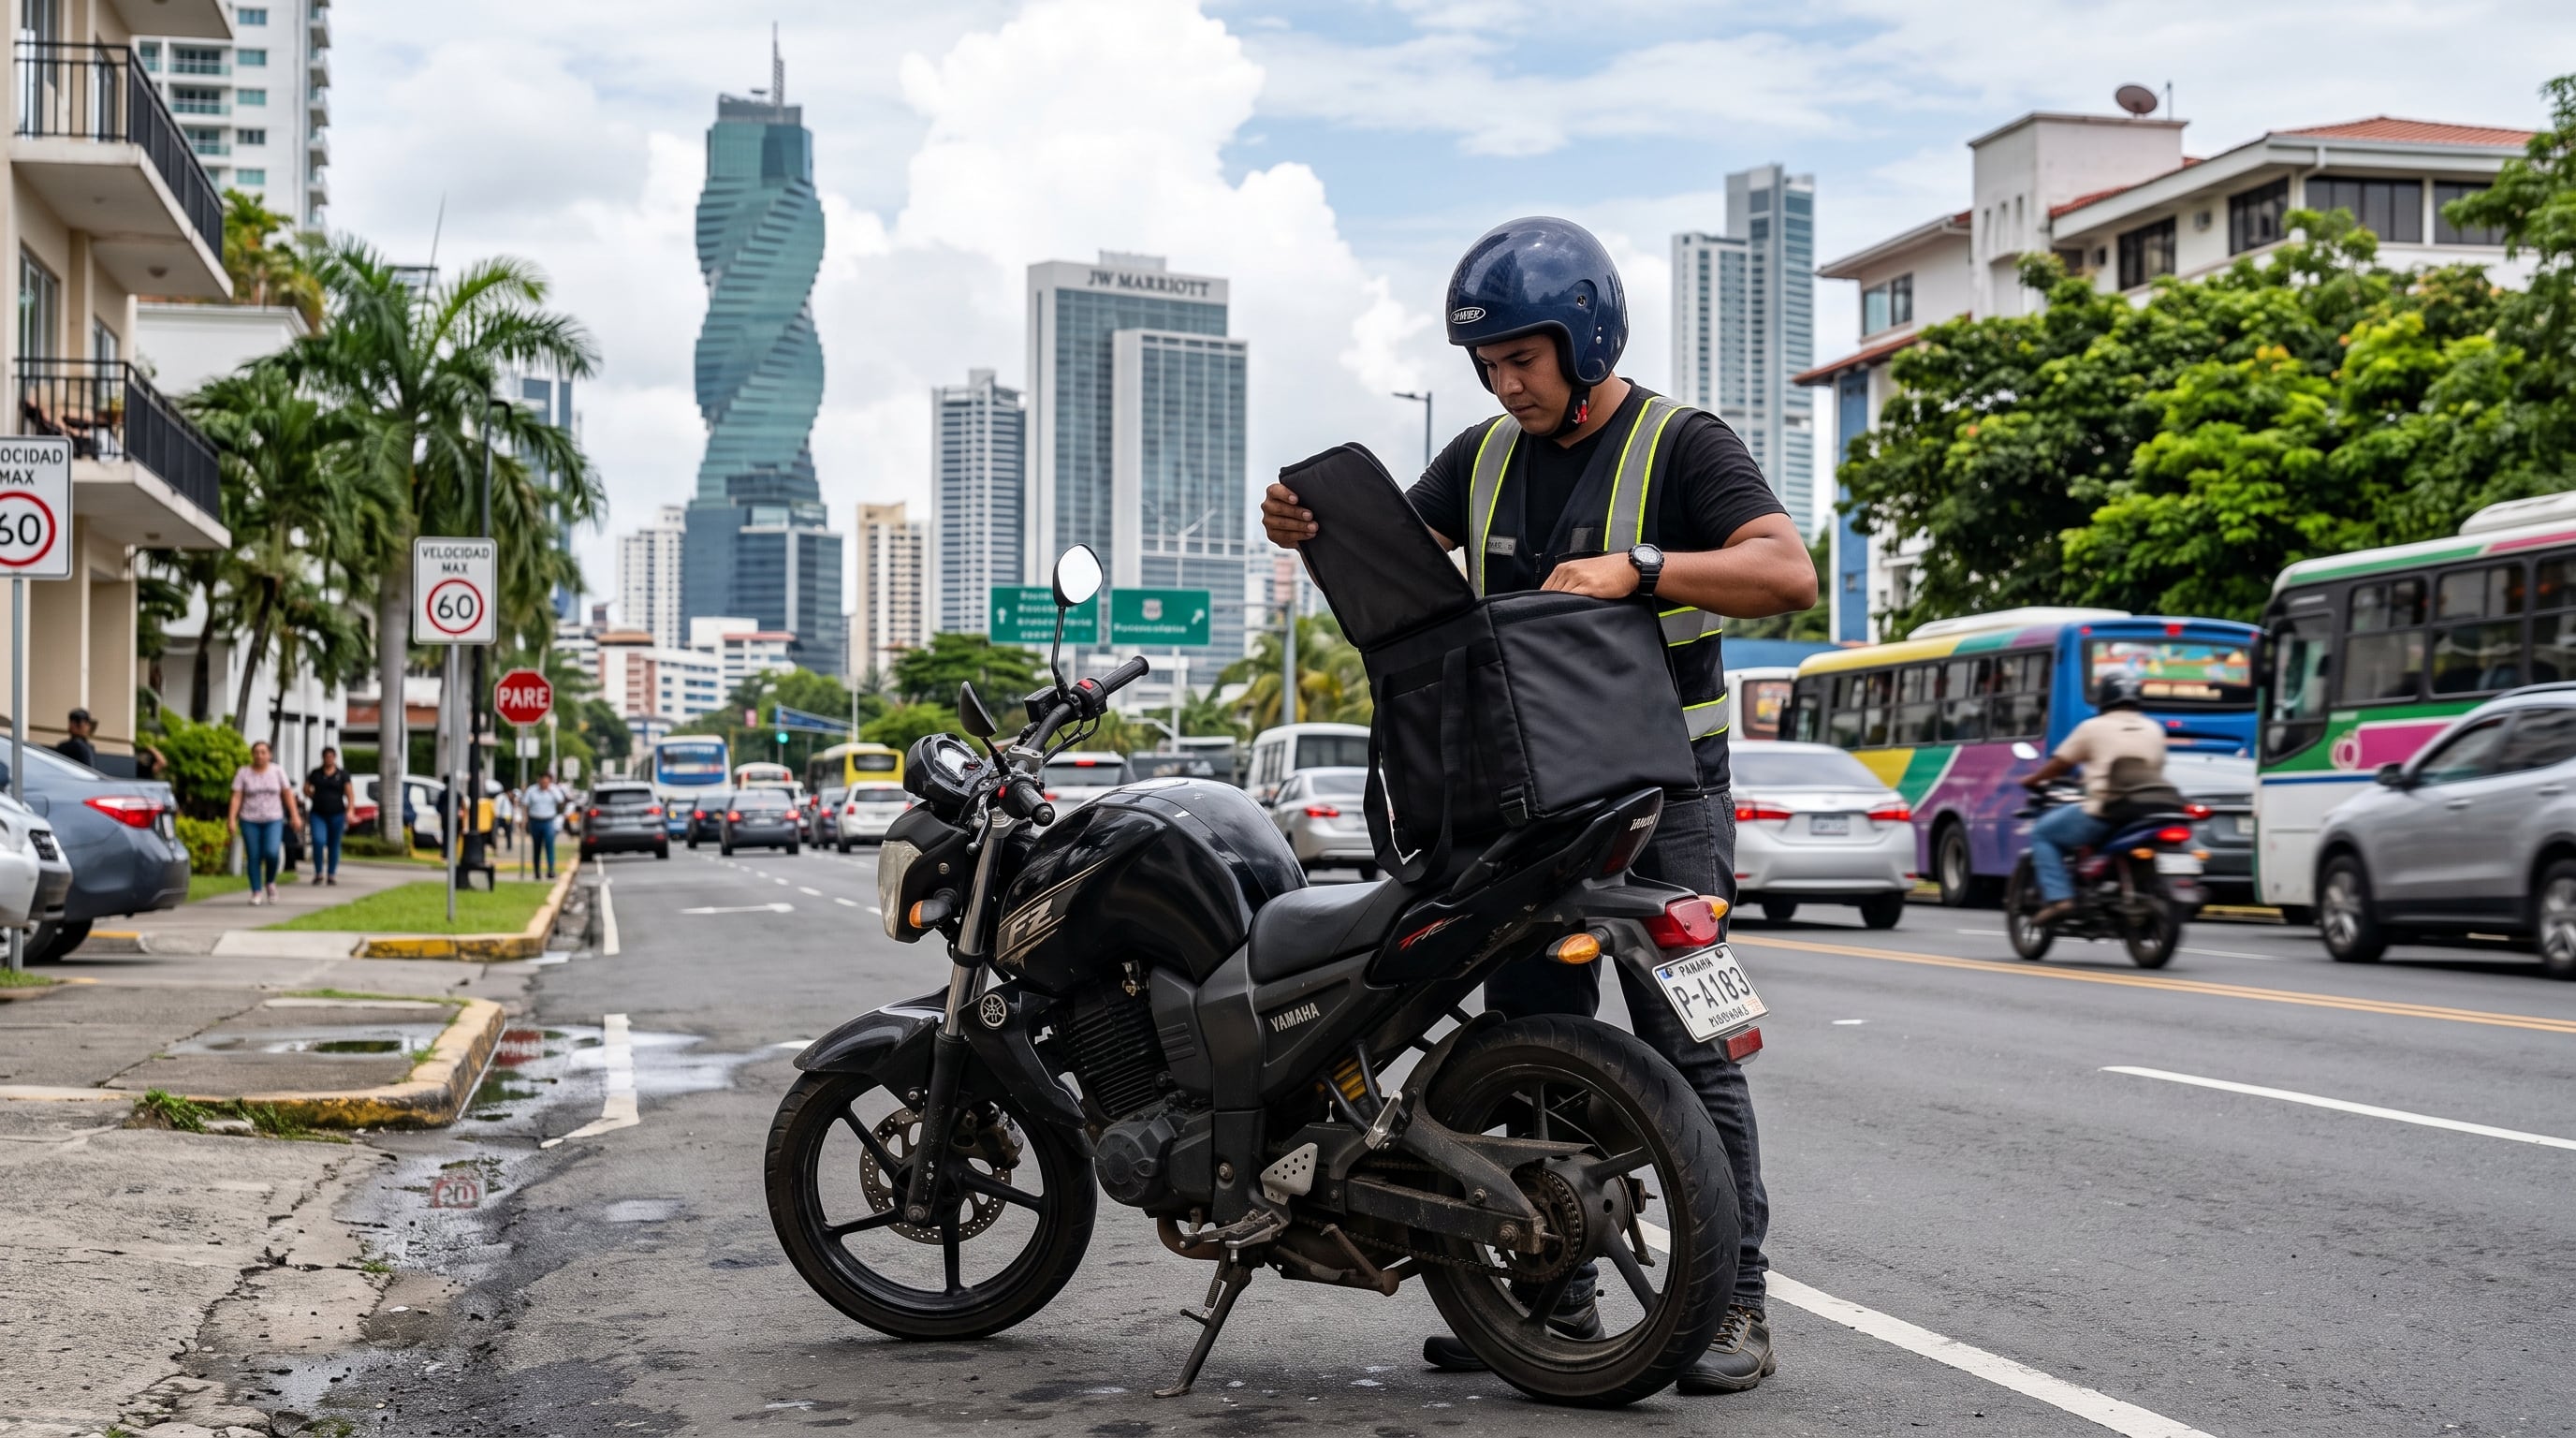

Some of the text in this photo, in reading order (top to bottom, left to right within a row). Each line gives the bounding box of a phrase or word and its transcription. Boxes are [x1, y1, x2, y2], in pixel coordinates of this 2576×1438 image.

[1088, 269, 1210, 297] JW MARRIOTT
[0, 469, 35, 486] MAX
[0, 512, 41, 546] 60
[422, 547, 490, 560] VELOCIDAD
[442, 563, 468, 574] MAX
[437, 594, 474, 620] 60
[499, 686, 549, 709] PARE
[1006, 898, 1053, 950] FZ
[1672, 966, 1750, 1020] P-A183
[1270, 1002, 1321, 1033] YAMAHA
